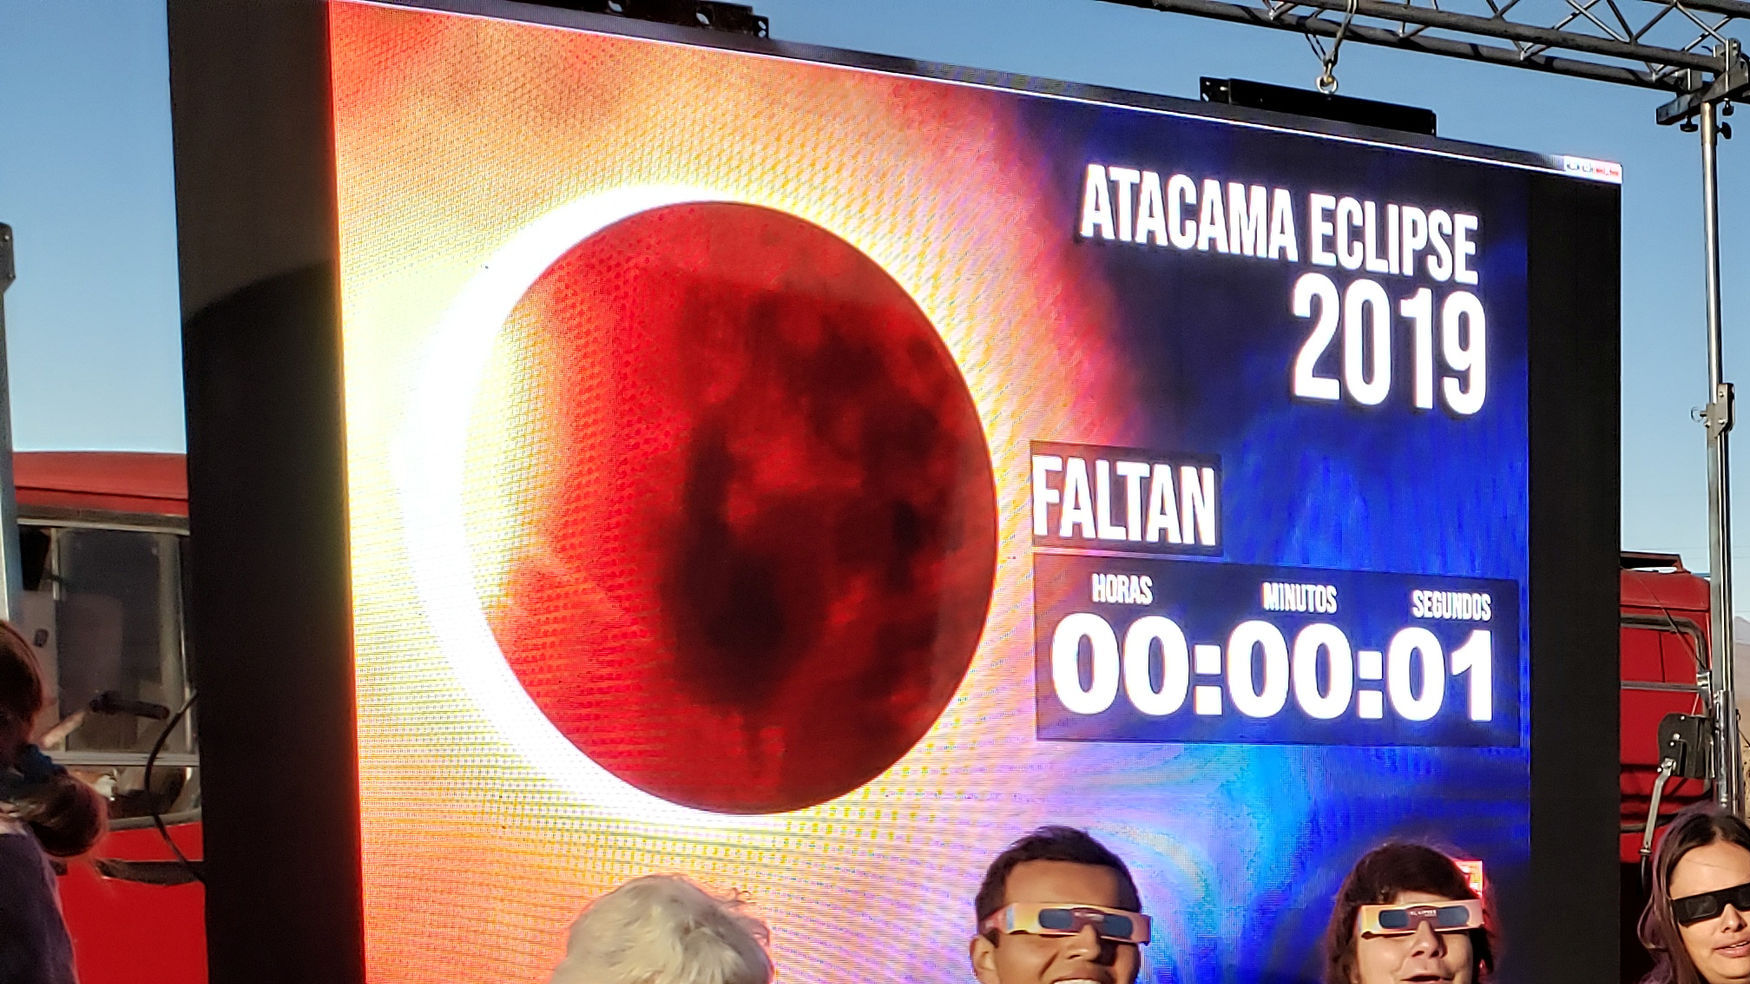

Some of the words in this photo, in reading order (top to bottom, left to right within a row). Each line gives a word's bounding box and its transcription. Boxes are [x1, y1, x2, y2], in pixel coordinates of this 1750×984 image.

[1079, 163, 1299, 262] ATACAMA
[1310, 193, 1479, 285] ECLIPSE
[1292, 272, 1487, 415] 2019
[1031, 454, 1216, 546] FALTAN
[1091, 573, 1153, 605] HORAS
[1262, 581, 1337, 614] MINUTOS
[1412, 589, 1492, 622] SEGUNDOS
[1051, 612, 1492, 722] 00:00:01
